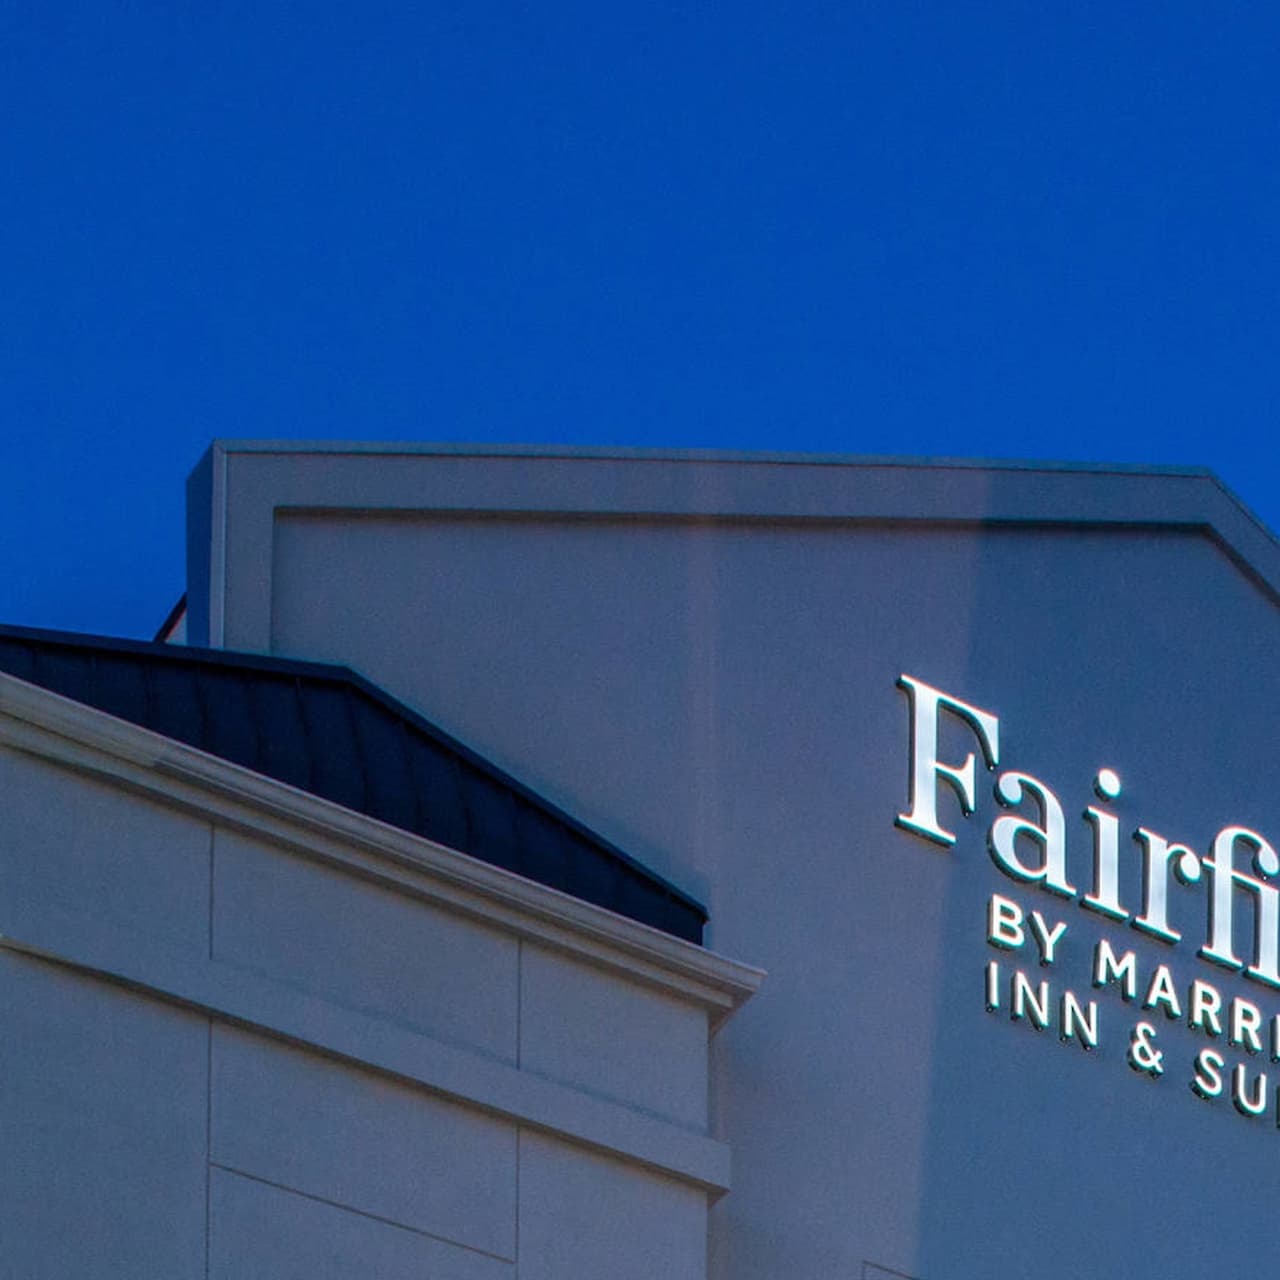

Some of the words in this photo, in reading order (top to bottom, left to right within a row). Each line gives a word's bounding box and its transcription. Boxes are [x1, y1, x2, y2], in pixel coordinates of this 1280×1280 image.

[988, 893, 1067, 964] BY
[986, 960, 1100, 1048] INN
[1129, 1021, 1165, 1075] &
